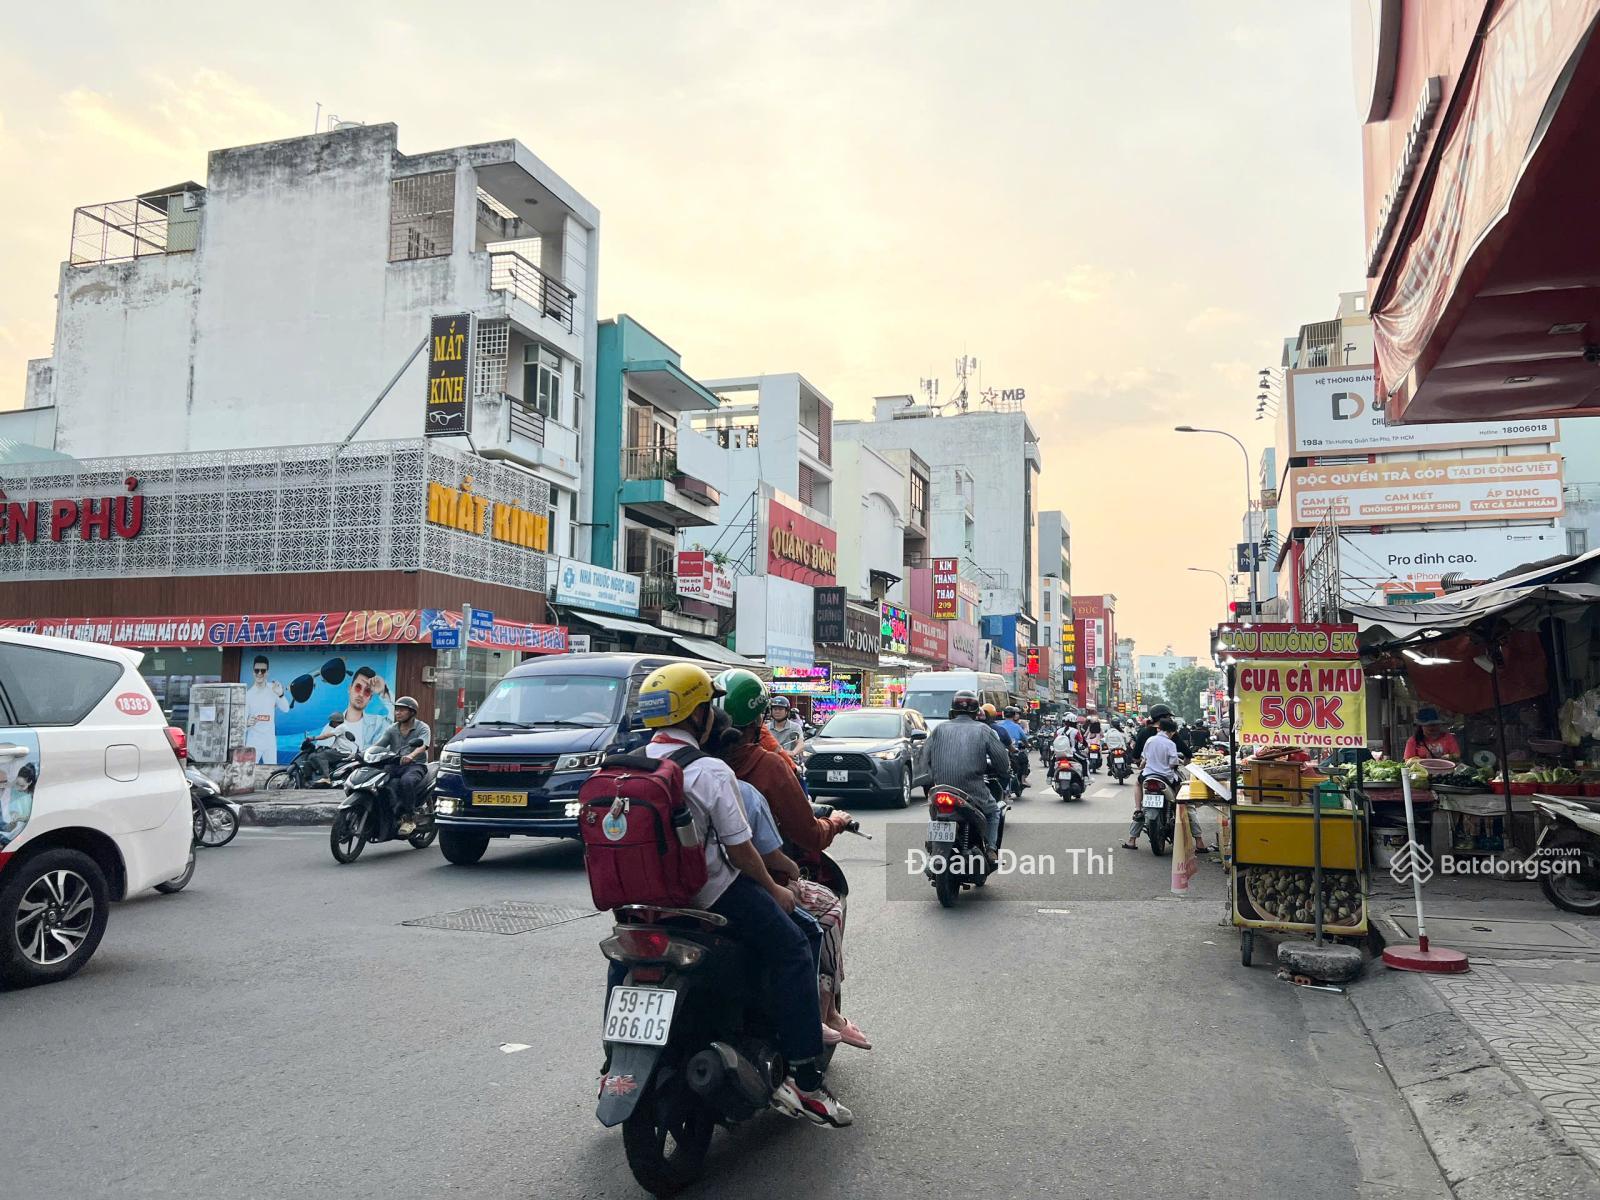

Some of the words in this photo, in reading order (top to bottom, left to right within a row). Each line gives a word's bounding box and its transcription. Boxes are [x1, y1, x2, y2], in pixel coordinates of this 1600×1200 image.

[434, 321, 464, 361] MẮT
[430, 370, 464, 404] KÍNH
[1327, 374, 1354, 384] THỐNG
[1356, 373, 1371, 382] BÁN
[1001, 388, 1025, 401] MB
[1502, 424, 1547, 434] 18006018
[1297, 473, 1327, 486] ĐỘC
[1331, 470, 1378, 485] QUYỀN
[1382, 467, 1411, 481] TRẢ
[1414, 467, 1446, 480] GÓP
[1474, 466, 1486, 475] DI
[1488, 463, 1524, 475] ĐỘNG
[1526, 463, 1552, 473] VIỆT
[1302, 497, 1326, 506] CAM
[1328, 495, 1349, 504] KẾT
[1385, 494, 1409, 502] CAM
[1413, 490, 1434, 500] KẾT
[1473, 500, 1490, 509] TẤT
[1491, 499, 1505, 508] CẢ
[1506, 498, 1526, 508] SẢN
[1486, 488, 1503, 498] ÁP
[51, 477, 144, 543] PHỦ
[426, 475, 489, 536] MẮT
[491, 498, 548, 553] KÍNH
[1362, 505, 1393, 513] KHÔNG
[1395, 503, 1410, 512] PHÍ
[1412, 502, 1435, 511] PHÁT
[1437, 502, 1458, 510] SINH
[771, 520, 811, 566] QUẢNG
[811, 537, 837, 575] ĐÔNG
[939, 560, 952, 571] KIM
[1388, 554, 1411, 566] Pro
[1414, 553, 1445, 565] đỉnh
[1448, 553, 1477, 564] cao.
[580, 568, 592, 585] NHÀ
[593, 571, 610, 588] THUỐC
[611, 575, 625, 595] NGỌC
[680, 583, 701, 593] THẢO
[935, 572, 957, 584] THÀNH
[936, 585, 955, 600] THẢO
[114, 620, 134, 641] LÀM
[135, 619, 156, 641] KÍNH
[178, 619, 190, 641] CÓ
[191, 618, 205, 645] ĐỘ
[208, 615, 277, 644] GIẢM
[283, 616, 328, 643] GIÁ
[490, 622, 541, 648] KHUYẾN
[857, 626, 880, 654] ĐÔNG
[1261, 626, 1328, 652] NƯỚNG
[1331, 632, 1357, 653] 5K
[1240, 668, 1280, 692] CUA
[1285, 664, 1313, 692] CÀ
[1318, 668, 1362, 692] MAU
[118, 698, 148, 711] 18383
[1260, 696, 1344, 730] 50K
[1243, 733, 1269, 744] BAO
[1272, 731, 1290, 745] ĂN
[1294, 732, 1332, 746] TỪNG
[1335, 735, 1363, 746] CON
[619, 991, 664, 1015] 59-F1
[608, 1016, 666, 1041] 866.05
